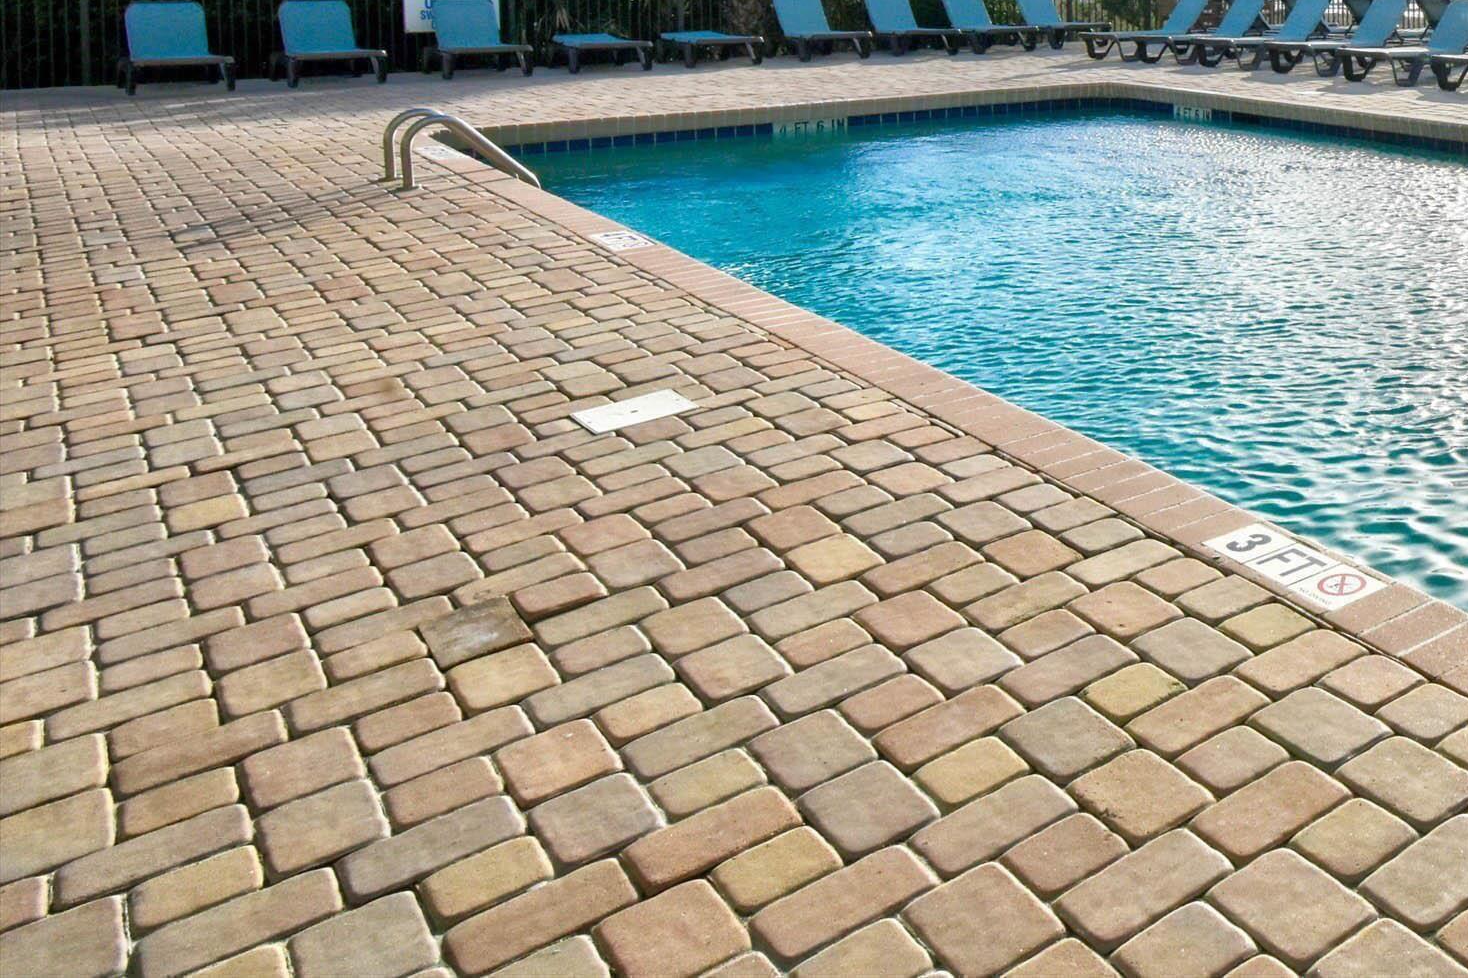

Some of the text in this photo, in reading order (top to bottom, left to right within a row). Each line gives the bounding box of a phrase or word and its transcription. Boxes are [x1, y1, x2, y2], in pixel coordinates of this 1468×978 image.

[794, 120, 809, 134] FT
[1226, 533, 1327, 577] 3 FT
